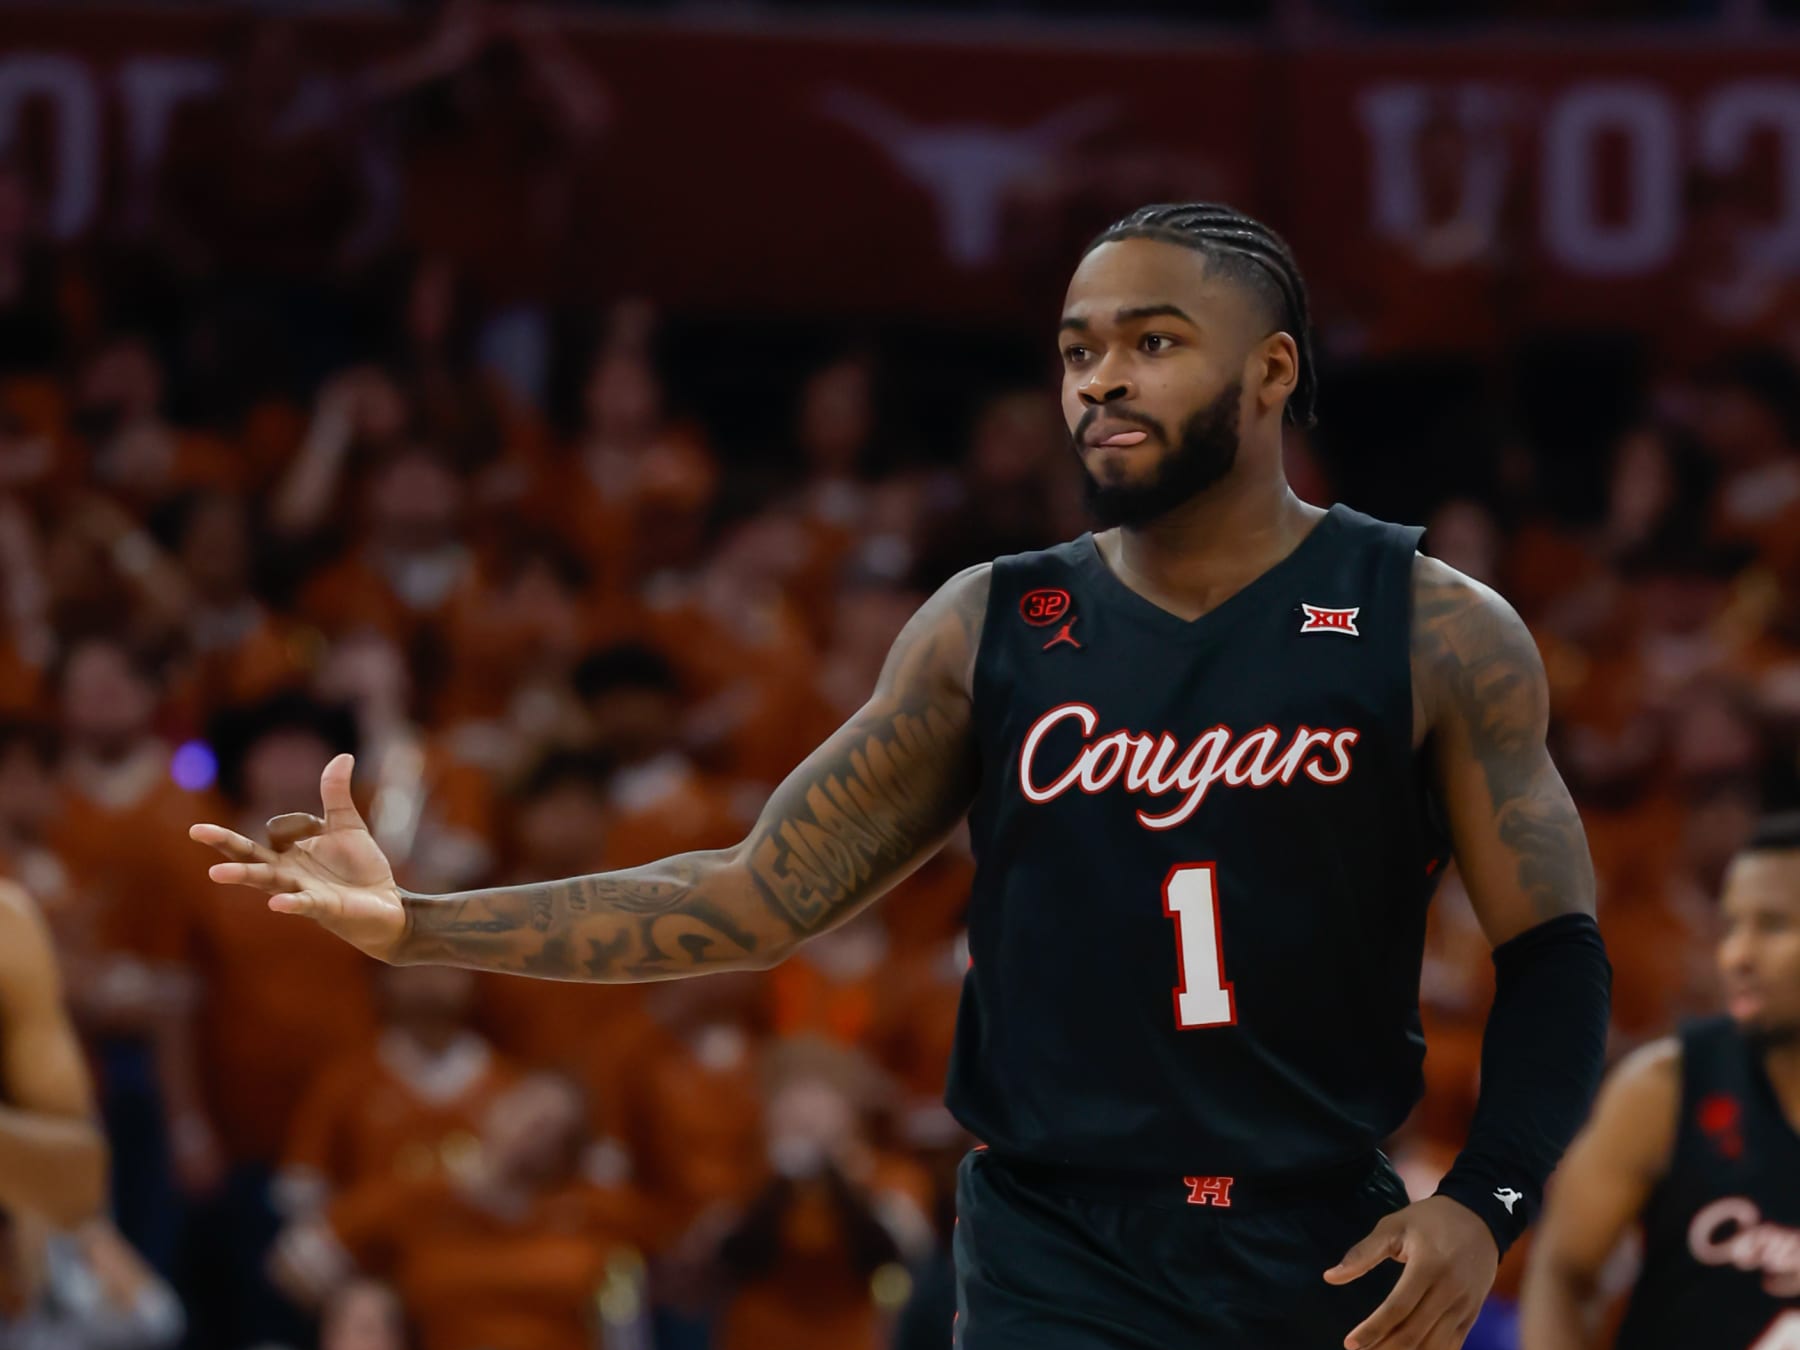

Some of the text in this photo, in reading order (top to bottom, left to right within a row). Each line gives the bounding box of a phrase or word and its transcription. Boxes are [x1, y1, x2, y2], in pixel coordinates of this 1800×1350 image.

[1029, 595, 1062, 617] 32
[1303, 606, 1357, 633] XII
[1019, 702, 1360, 831] Cougars
[1160, 861, 1238, 1030] 1
